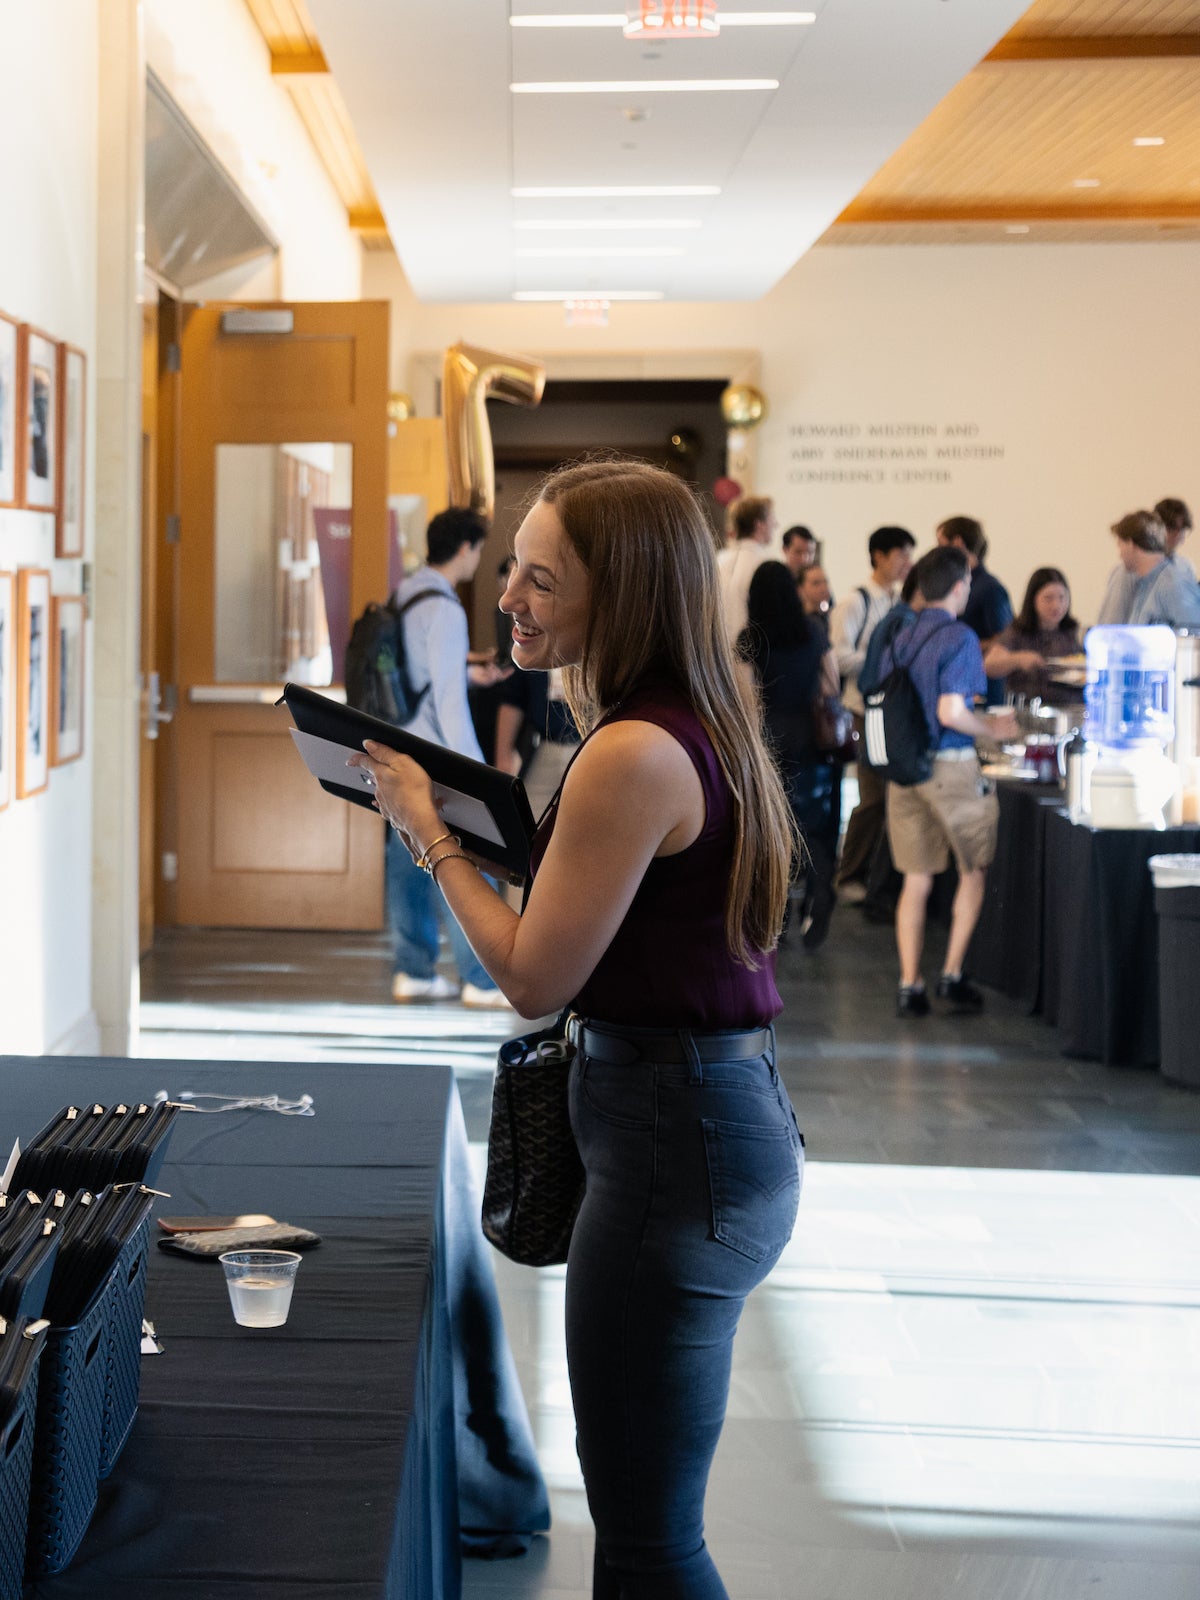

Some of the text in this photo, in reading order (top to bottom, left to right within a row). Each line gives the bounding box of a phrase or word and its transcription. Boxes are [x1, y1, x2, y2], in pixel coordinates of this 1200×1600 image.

[945, 424, 979, 437] AND
[791, 446, 823, 460] ABBY
[789, 469, 951, 483] CONFERENCE CENTER
